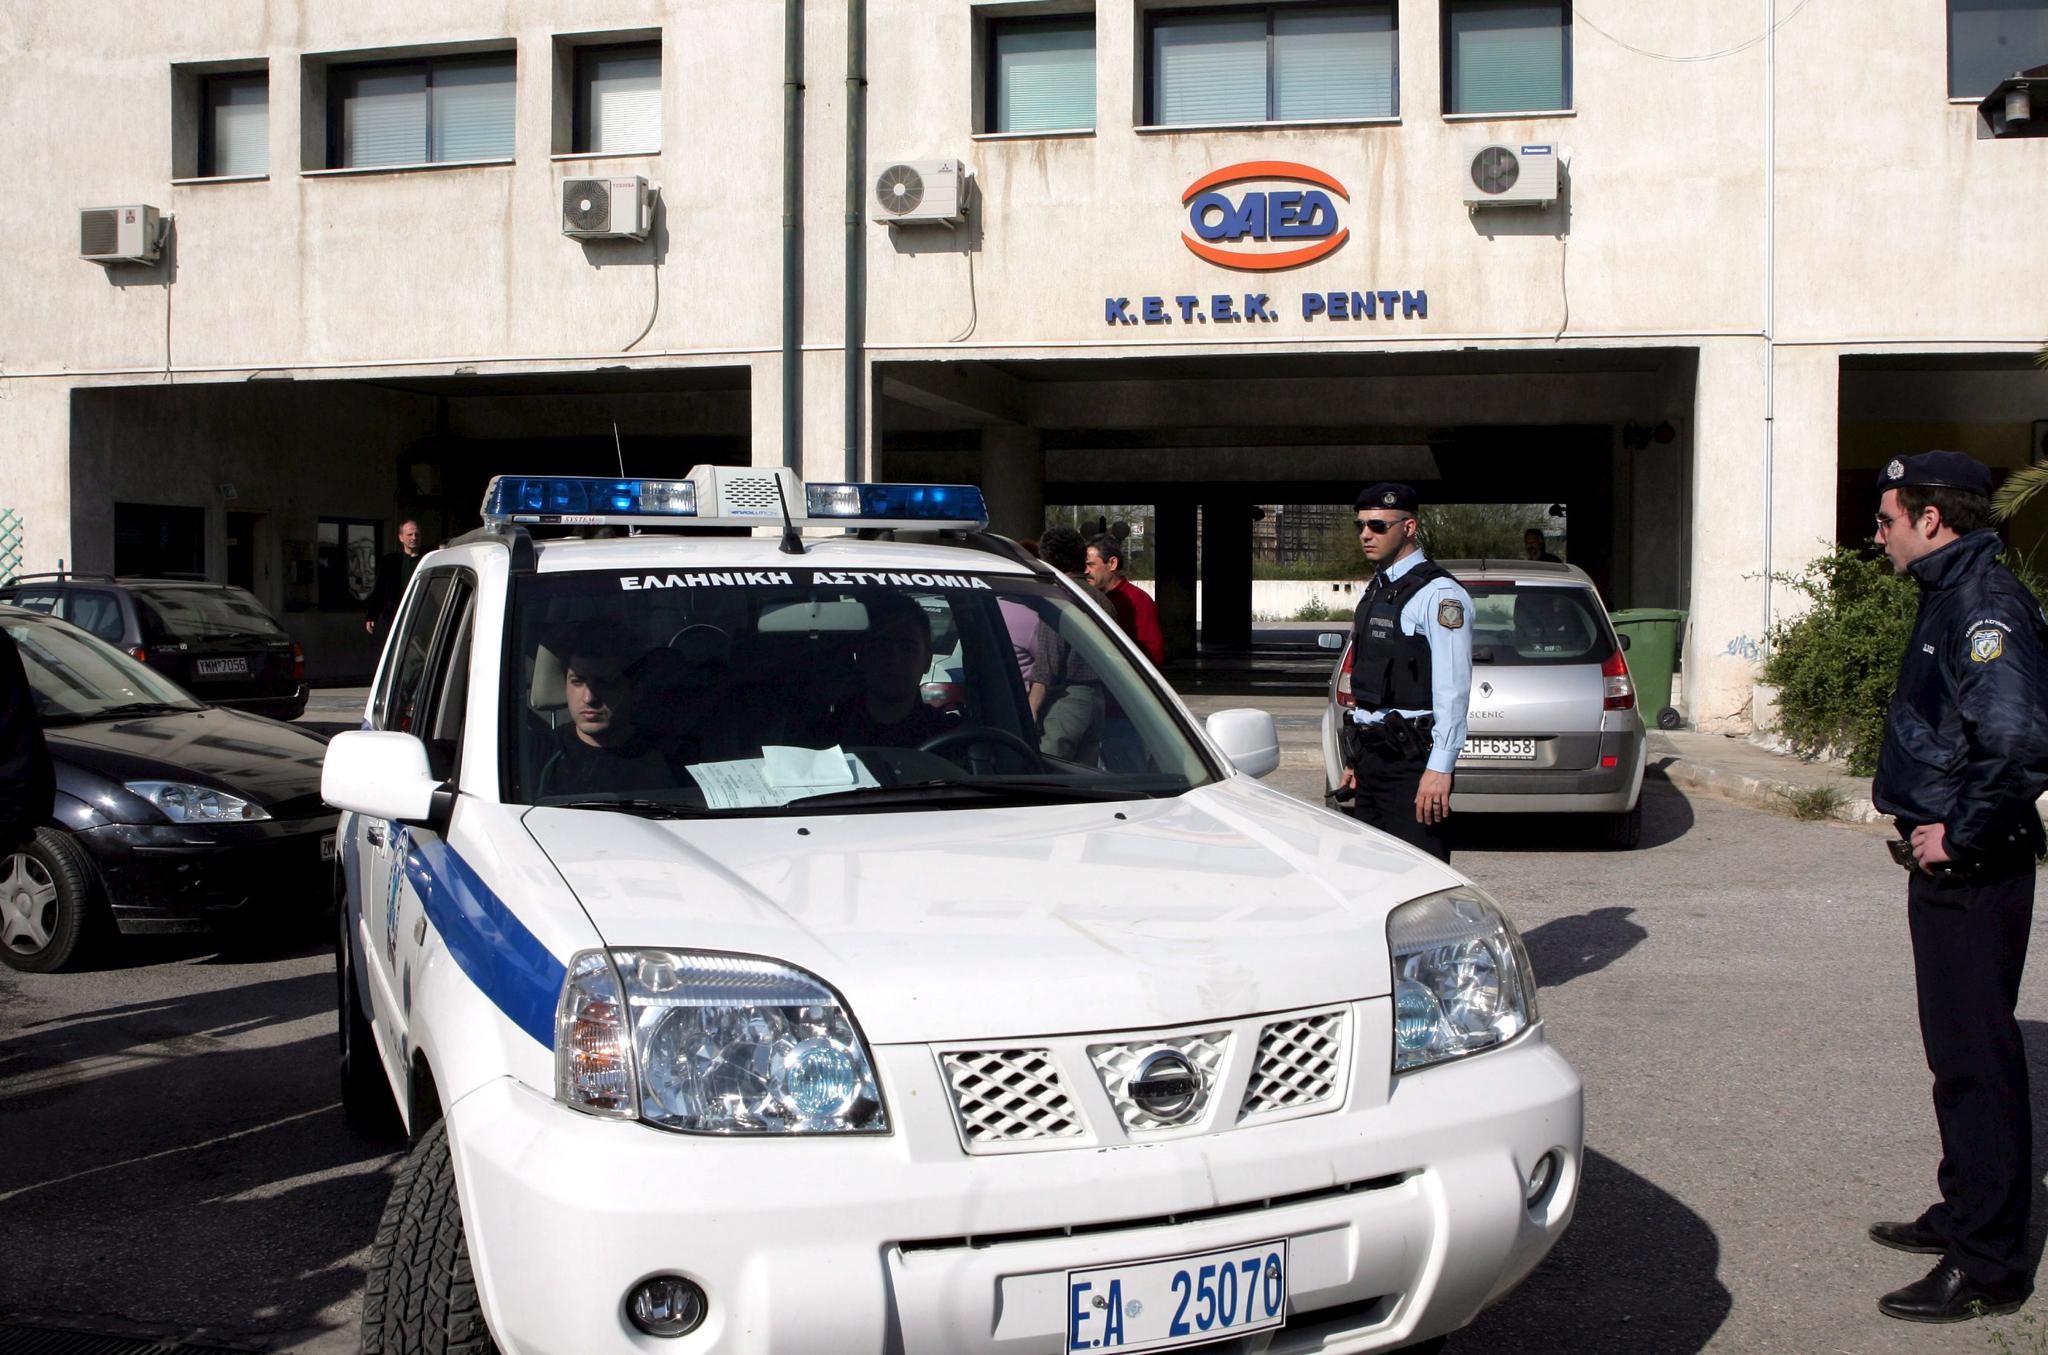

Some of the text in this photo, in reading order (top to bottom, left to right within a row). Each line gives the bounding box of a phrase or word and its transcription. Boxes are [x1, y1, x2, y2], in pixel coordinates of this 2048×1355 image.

[1302, 290, 1427, 321] ΡΕΝΤΗ
[620, 571, 992, 591] ΕΛΛΗΝΙΚΗ ΑΣΤΥΝΟΜΙΑ
[1372, 630, 1386, 639] POLICE
[1469, 711, 1505, 719] SCENIC
[1169, 1252, 1282, 1338] 25070
